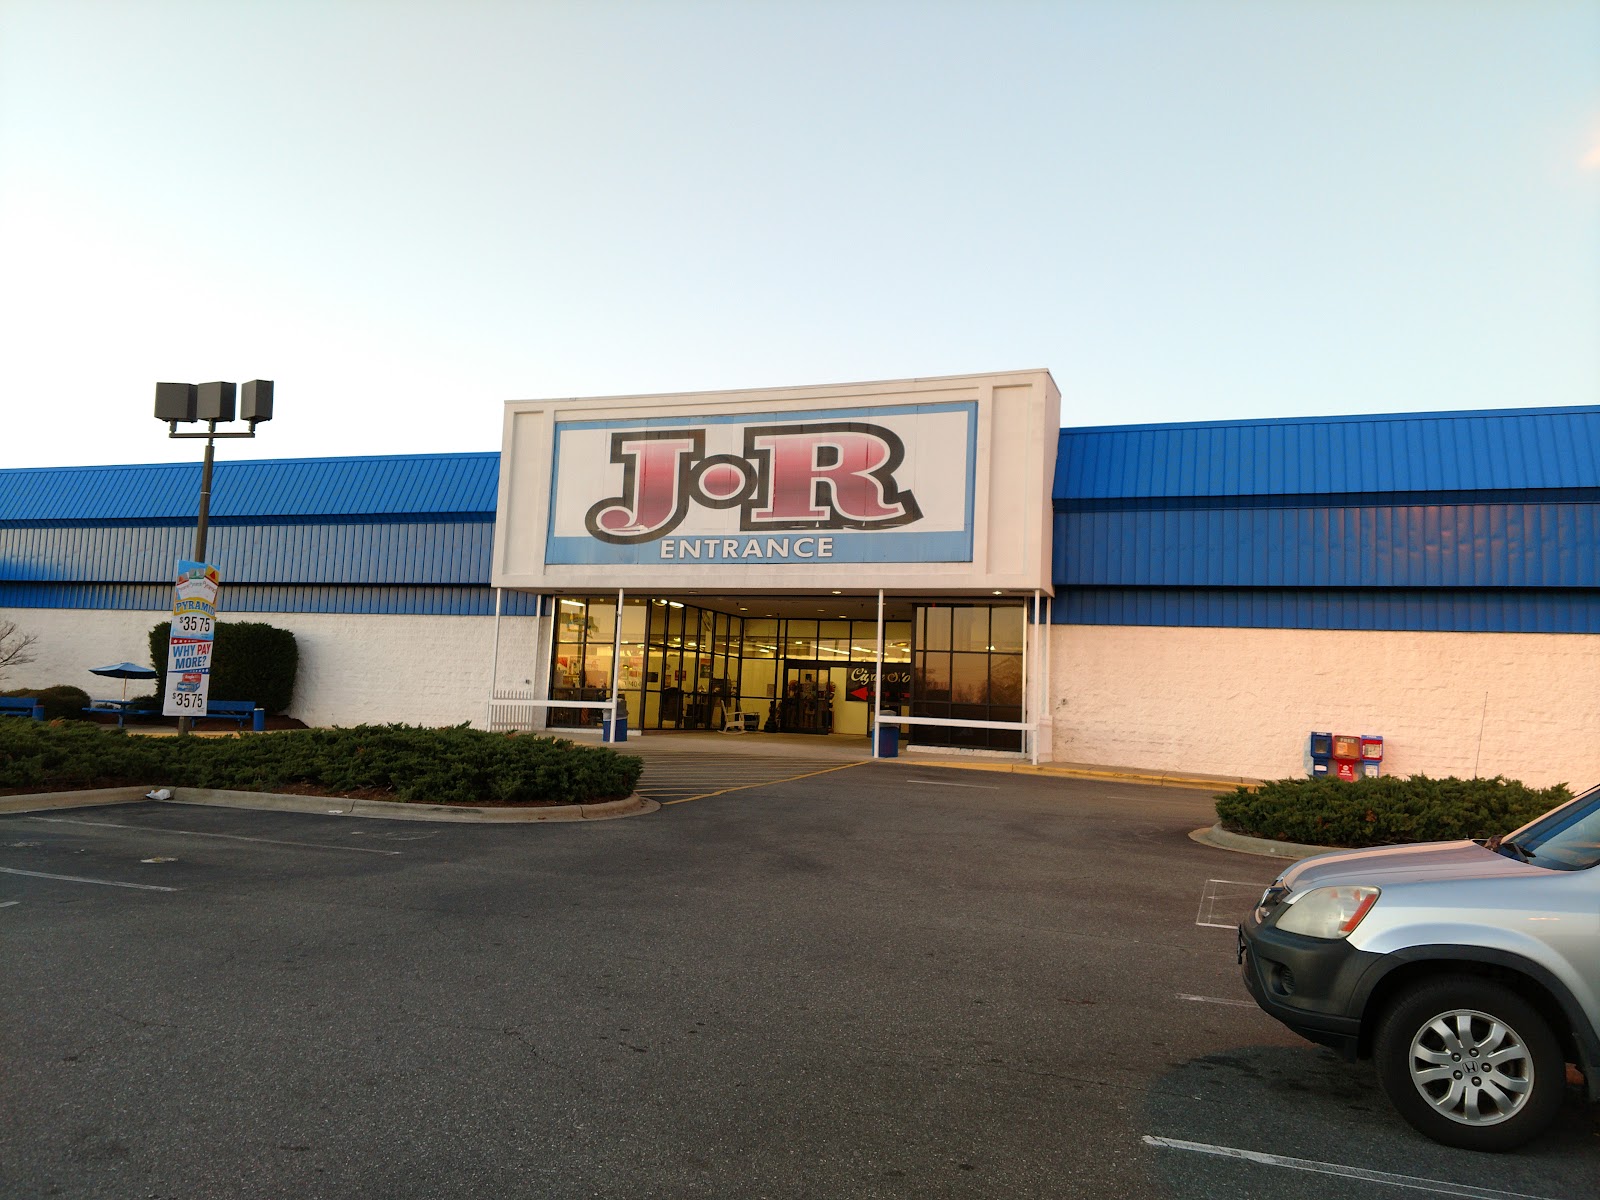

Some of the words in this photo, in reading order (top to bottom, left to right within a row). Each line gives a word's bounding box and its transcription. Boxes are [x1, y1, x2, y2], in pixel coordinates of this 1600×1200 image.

[660, 537, 833, 559] ENTRANCE
[176, 600, 215, 616] PYRAMID
[173, 644, 195, 658] WHY
[196, 643, 211, 656] PAY
[175, 655, 207, 669] MORE?
